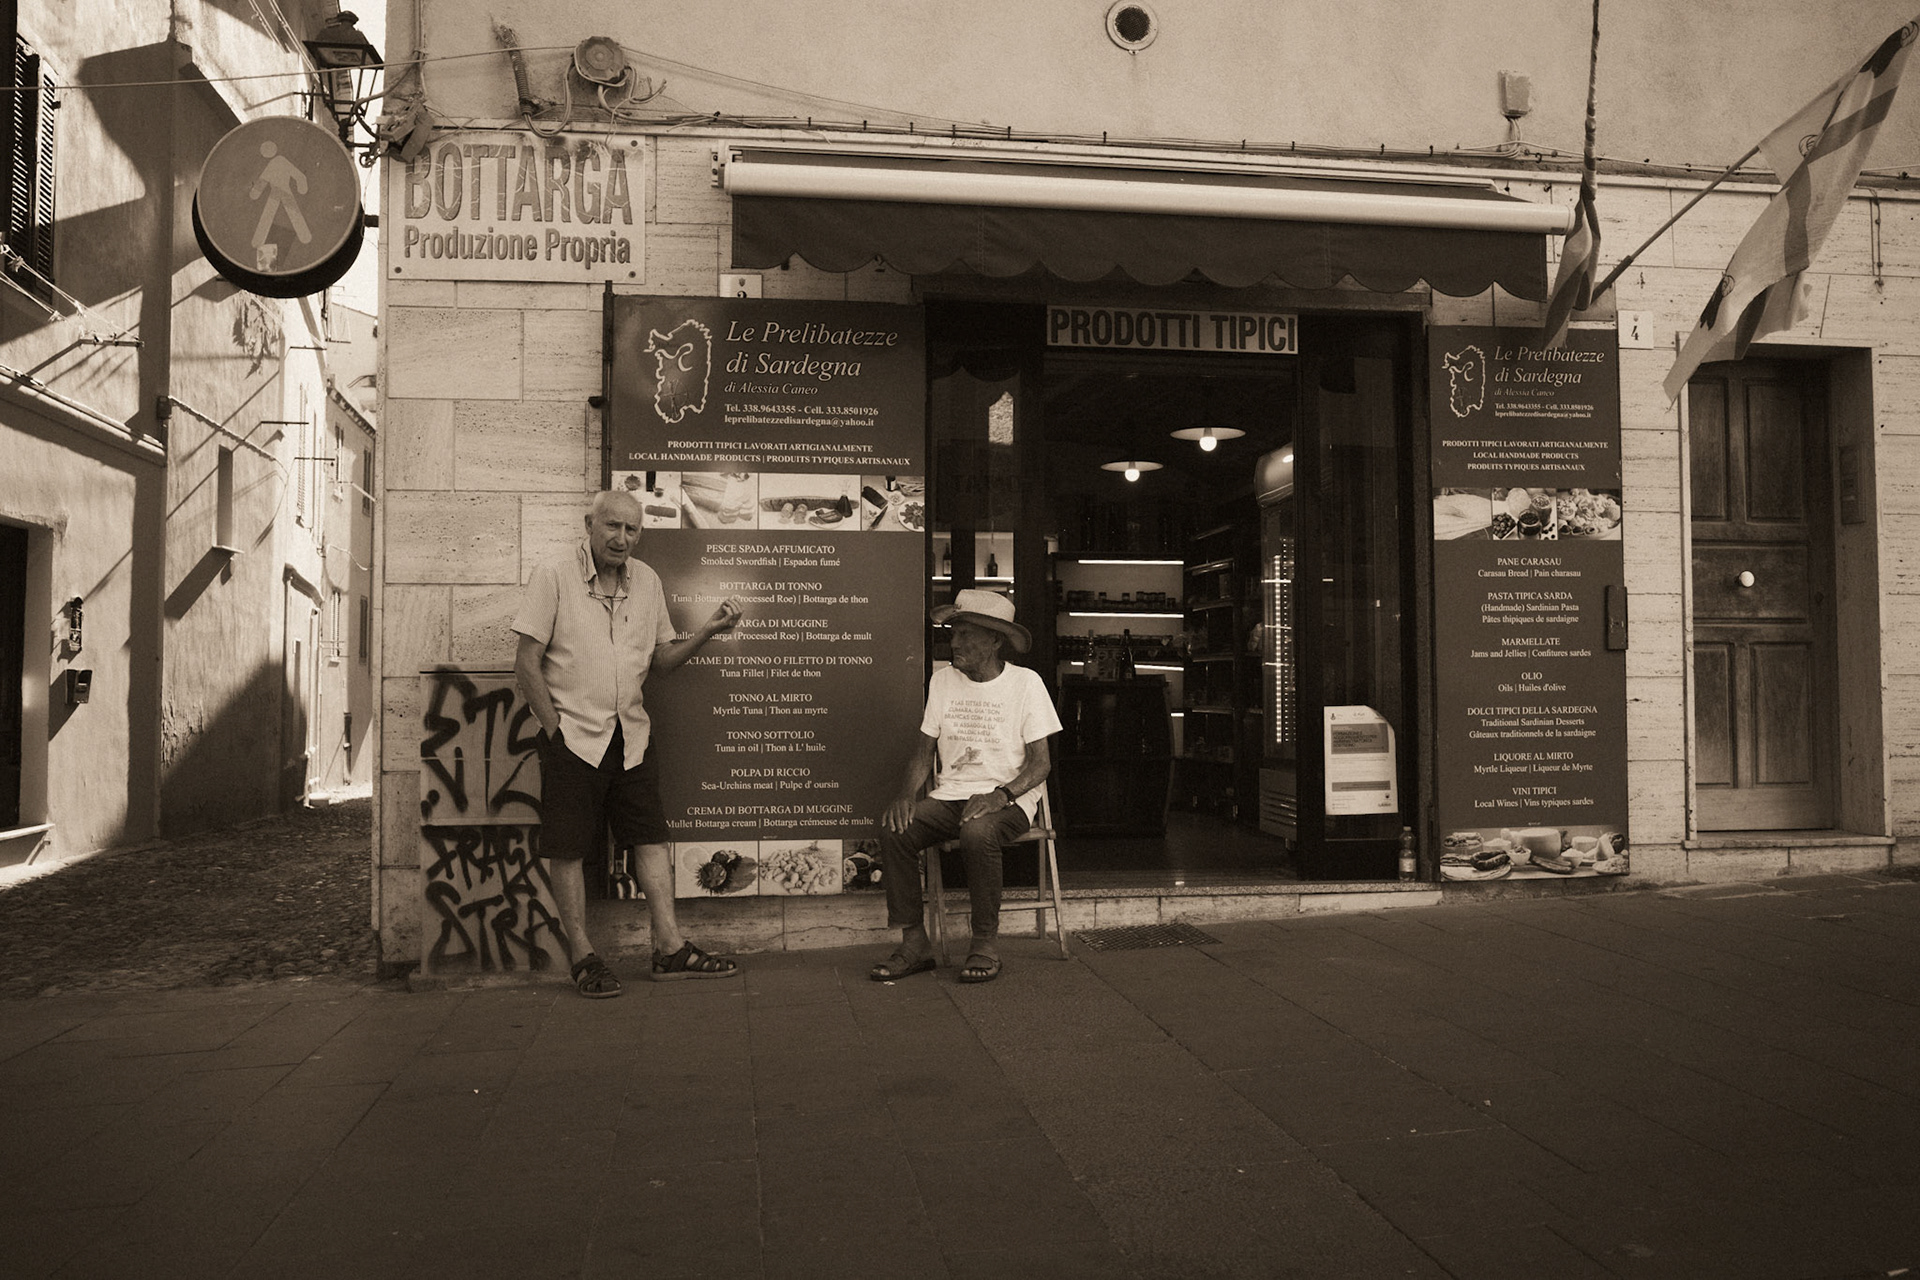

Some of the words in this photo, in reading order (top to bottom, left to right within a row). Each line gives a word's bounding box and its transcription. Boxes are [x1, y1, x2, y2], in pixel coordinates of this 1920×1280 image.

[404, 142, 633, 225] BOTTARGA
[404, 224, 538, 261] Produzione
[545, 228, 631, 270] Propria
[727, 321, 755, 342] Le
[762, 322, 898, 346] Prelibatezze
[1050, 309, 1202, 349] PRODOTTI
[1210, 314, 1296, 352] TIPICI
[1630, 326, 1640, 341] 4
[1494, 346, 1513, 361] Le
[1517, 347, 1605, 363] Prelibatezze
[726, 352, 749, 373] di
[755, 354, 861, 381] Sardegna
[1495, 367, 1510, 382] di
[1513, 368, 1582, 387] Sardegna
[724, 382, 736, 393] di
[738, 382, 779, 394] Alessia
[782, 383, 818, 395] Caneo
[724, 404, 741, 412] Tel.
[742, 404, 796, 414] 338.9643355
[804, 406, 824, 414] Cell.
[826, 407, 879, 416] 333.8501926
[724, 416, 874, 427] leprelibatezzedisardegna@yahoo.it
[667, 441, 714, 449] PRODOTTI
[714, 442, 742, 450] TIPICI
[788, 444, 874, 452] ARTIGIANALMENTE
[1540, 441, 1609, 449] ARTIGIANALMENTE
[660, 453, 713, 461] HANDMADE
[714, 454, 762, 462] PRODUCTS
[766, 455, 811, 463] PRODUITS
[811, 456, 855, 465] TYPIQUES
[855, 457, 911, 466] ARTISANAUX
[706, 544, 738, 553] PESCE
[738, 545, 771, 554] SPADA
[772, 545, 836, 554] AFFUMICATO
[701, 557, 734, 566] Smoked
[736, 557, 777, 566] Swordfish
[783, 558, 818, 568] Espadon
[820, 558, 841, 567] fumé
[1497, 558, 1520, 566] PANE
[1520, 558, 1562, 566] CARASAU
[1478, 569, 1507, 578] Carasau
[1508, 569, 1529, 577] Bread
[1534, 569, 1550, 577] Pain
[1551, 569, 1582, 577] charasau
[719, 582, 774, 590] BOTTARGA
[787, 582, 823, 591] TONNO
[672, 594, 693, 603] Tuna
[777, 594, 797, 604] Roe)
[803, 595, 838, 605] Bottarga
[850, 595, 869, 604] thon
[1488, 592, 1514, 600] PASTA
[1514, 592, 1543, 600] TIPICA
[1543, 592, 1573, 600] SARDA
[1481, 604, 1525, 612] (Handmade)
[1526, 603, 1560, 612] Sardinian
[1561, 603, 1580, 611] Pasta
[781, 619, 829, 628] MUGGINE
[1482, 615, 1501, 623] Pâtes
[1502, 615, 1534, 625] thipiques
[1546, 615, 1579, 624] sardaigne
[734, 632, 778, 642] (Processed
[780, 632, 800, 641] Roe)
[806, 632, 840, 642] Bottarga
[853, 632, 872, 640] mult
[1501, 638, 1561, 646] MARMELLATE
[1470, 650, 1489, 658] Jams
[1490, 650, 1504, 658] and
[1504, 649, 1527, 658] Jellies
[1532, 649, 1568, 657] Confitures
[1569, 649, 1592, 657] sardes
[736, 656, 772, 665] TONNO
[783, 656, 824, 665] FILETTO
[838, 656, 873, 665] TONNO
[720, 669, 741, 678] Tuna
[743, 669, 765, 678] Fillet
[771, 669, 790, 678] Filet
[803, 669, 822, 677] thon
[1521, 672, 1543, 680] OLIO
[1498, 684, 1514, 692] Oils
[1518, 684, 1542, 692] Huiles
[1542, 683, 1567, 692] d'olive
[728, 694, 765, 702] TONNO
[765, 694, 780, 702] AL
[781, 694, 813, 702] MIRTO
[713, 706, 741, 717] Myrtle
[742, 706, 764, 715] Tuna
[769, 706, 791, 715] Thon
[804, 708, 828, 716] myrte
[1467, 707, 1494, 716] DOLCI
[1495, 707, 1521, 715] TIPICI
[1522, 706, 1551, 715] DELLA
[1551, 706, 1598, 714] SARDEGNA
[1481, 719, 1520, 727] Traditional
[1521, 718, 1555, 726] Sardinian
[1556, 718, 1585, 726] Desserts
[726, 731, 762, 740] TONNO
[763, 731, 815, 740] SOTT'OLIO
[1469, 731, 1499, 739] Gâteaux
[1500, 730, 1544, 738] traditionnels
[1563, 729, 1596, 738] sardaigne
[714, 744, 736, 753] Tuna
[765, 743, 787, 752] Thon
[805, 743, 826, 752] huile
[1494, 753, 1532, 762] LIQUORE
[1546, 752, 1574, 760] MIRTO
[731, 769, 762, 777] POLPA
[776, 768, 811, 777] RICCIO
[1474, 765, 1498, 775] Myrtle
[1500, 765, 1528, 774] Liqueur
[1533, 764, 1560, 774] Liqueur
[1572, 763, 1593, 773] Myrte
[701, 781, 752, 790] Sea-Urchins
[753, 782, 774, 790] meat
[780, 781, 803, 791] Pulpe
[813, 780, 840, 789] oursin
[1512, 787, 1530, 795] VINI
[1533, 787, 1556, 795] TIPICI
[1475, 800, 1495, 808] Local
[1496, 799, 1519, 807] Wines
[1541, 799, 1571, 808] typiques
[1572, 797, 1594, 806] sardes
[687, 807, 723, 816] CREMA
[738, 806, 792, 815] BOTTARGA
[806, 805, 853, 814] MUGGINE
[666, 820, 693, 828] Mullet
[695, 819, 730, 830] Bottarga
[763, 818, 798, 828] Bottarga
[799, 818, 838, 826] crémeuse
[851, 817, 874, 825] multe
